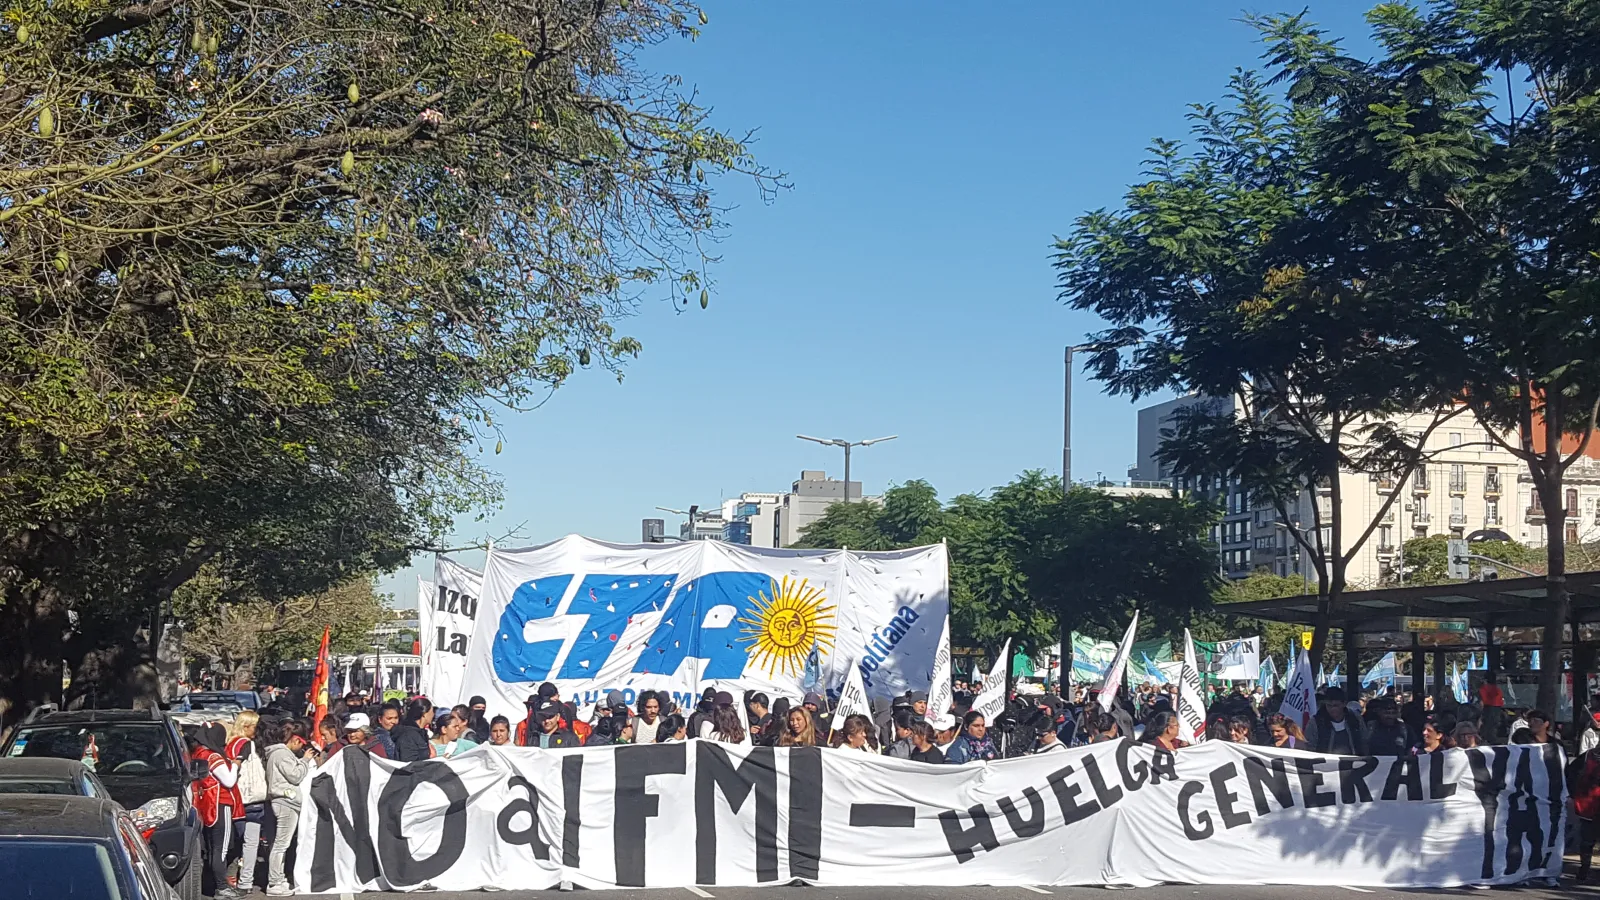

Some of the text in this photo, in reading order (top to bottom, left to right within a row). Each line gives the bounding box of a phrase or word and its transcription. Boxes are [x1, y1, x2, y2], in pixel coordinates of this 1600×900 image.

[437, 585, 477, 621] Izq
[435, 626, 468, 657] La
[845, 680, 862, 704] Izq
[310, 745, 469, 893] NO
[495, 754, 584, 869] al
[614, 739, 823, 888] FMI
[937, 737, 1179, 864] HUELGA
[1176, 749, 1457, 841] GENERAL
